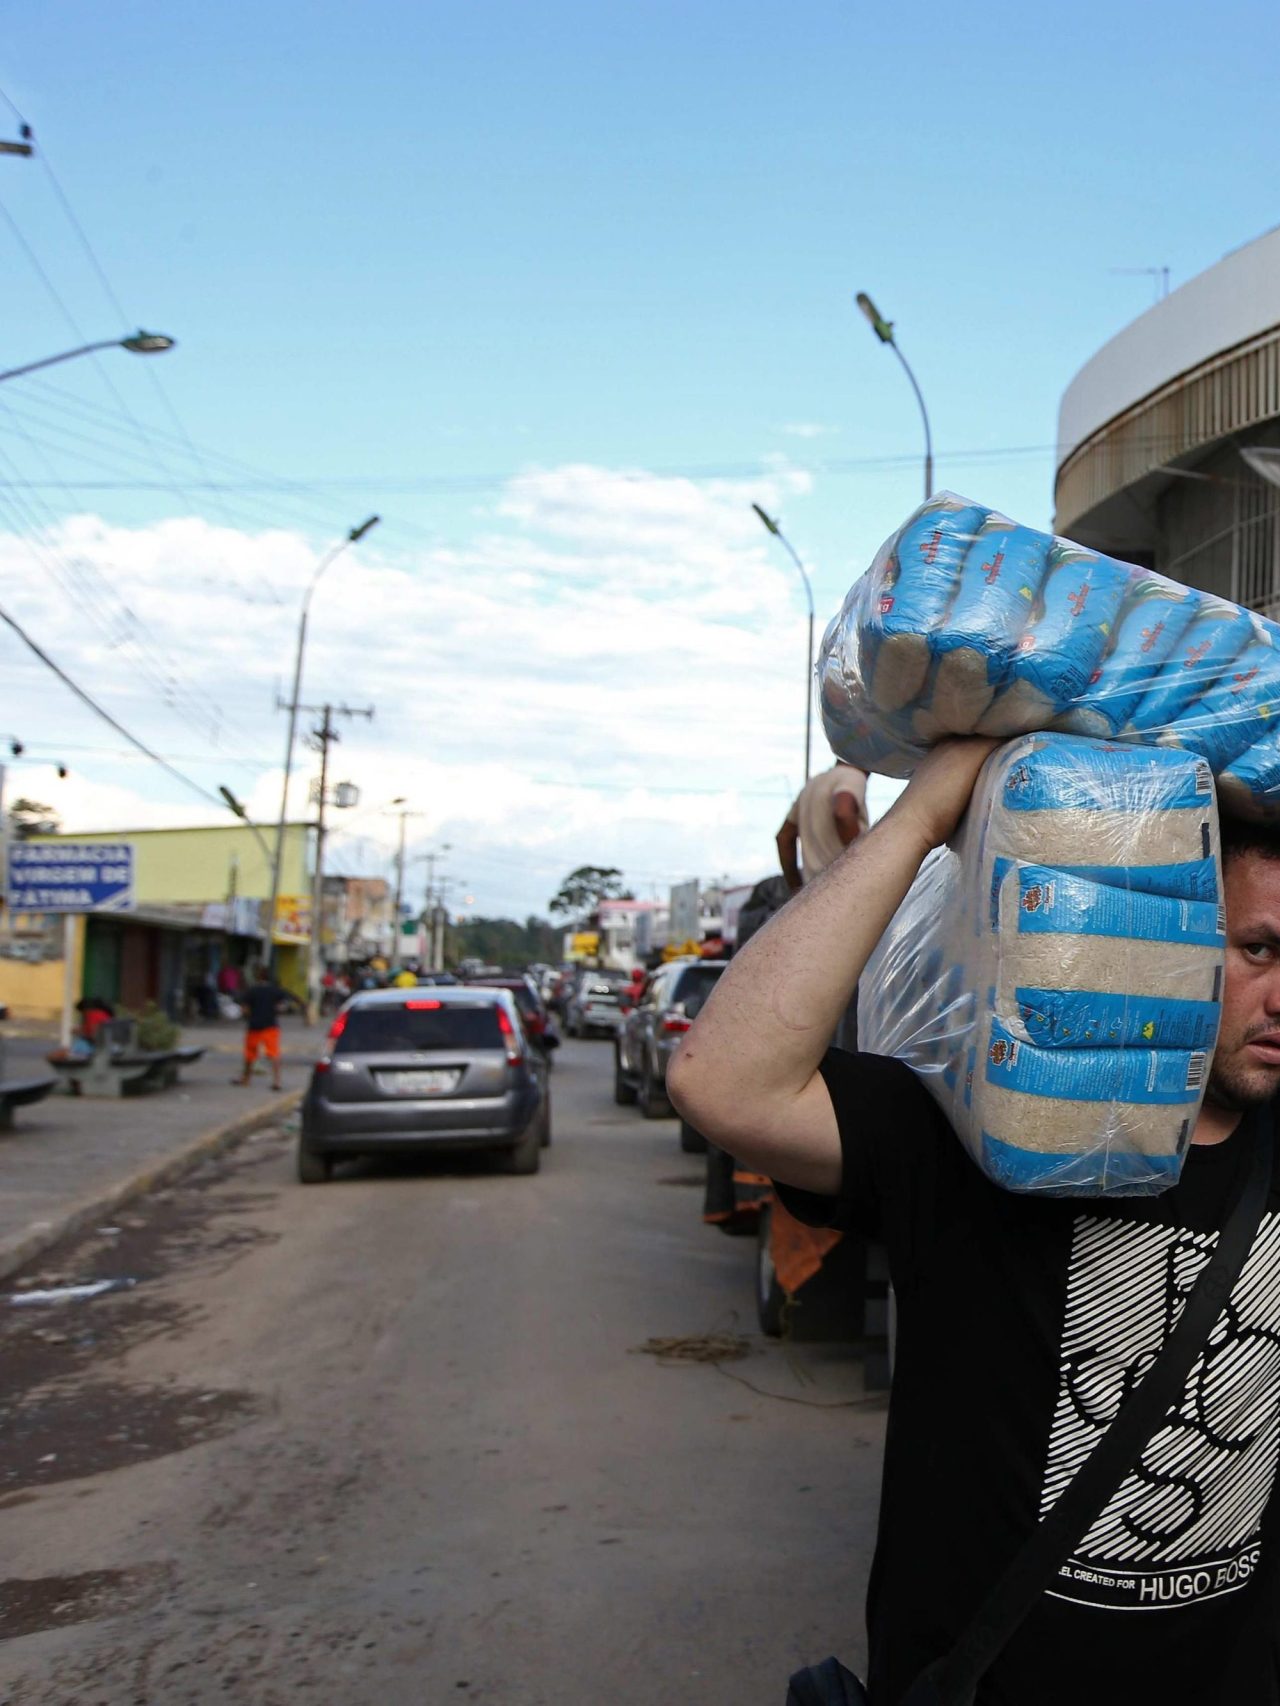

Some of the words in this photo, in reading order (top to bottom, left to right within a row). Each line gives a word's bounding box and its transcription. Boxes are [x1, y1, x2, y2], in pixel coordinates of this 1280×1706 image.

[101, 865, 130, 883] DE
[1073, 1569, 1116, 1587] CREATED
[1116, 1579, 1136, 1590] FOR
[1139, 1571, 1211, 1601] HUGO
